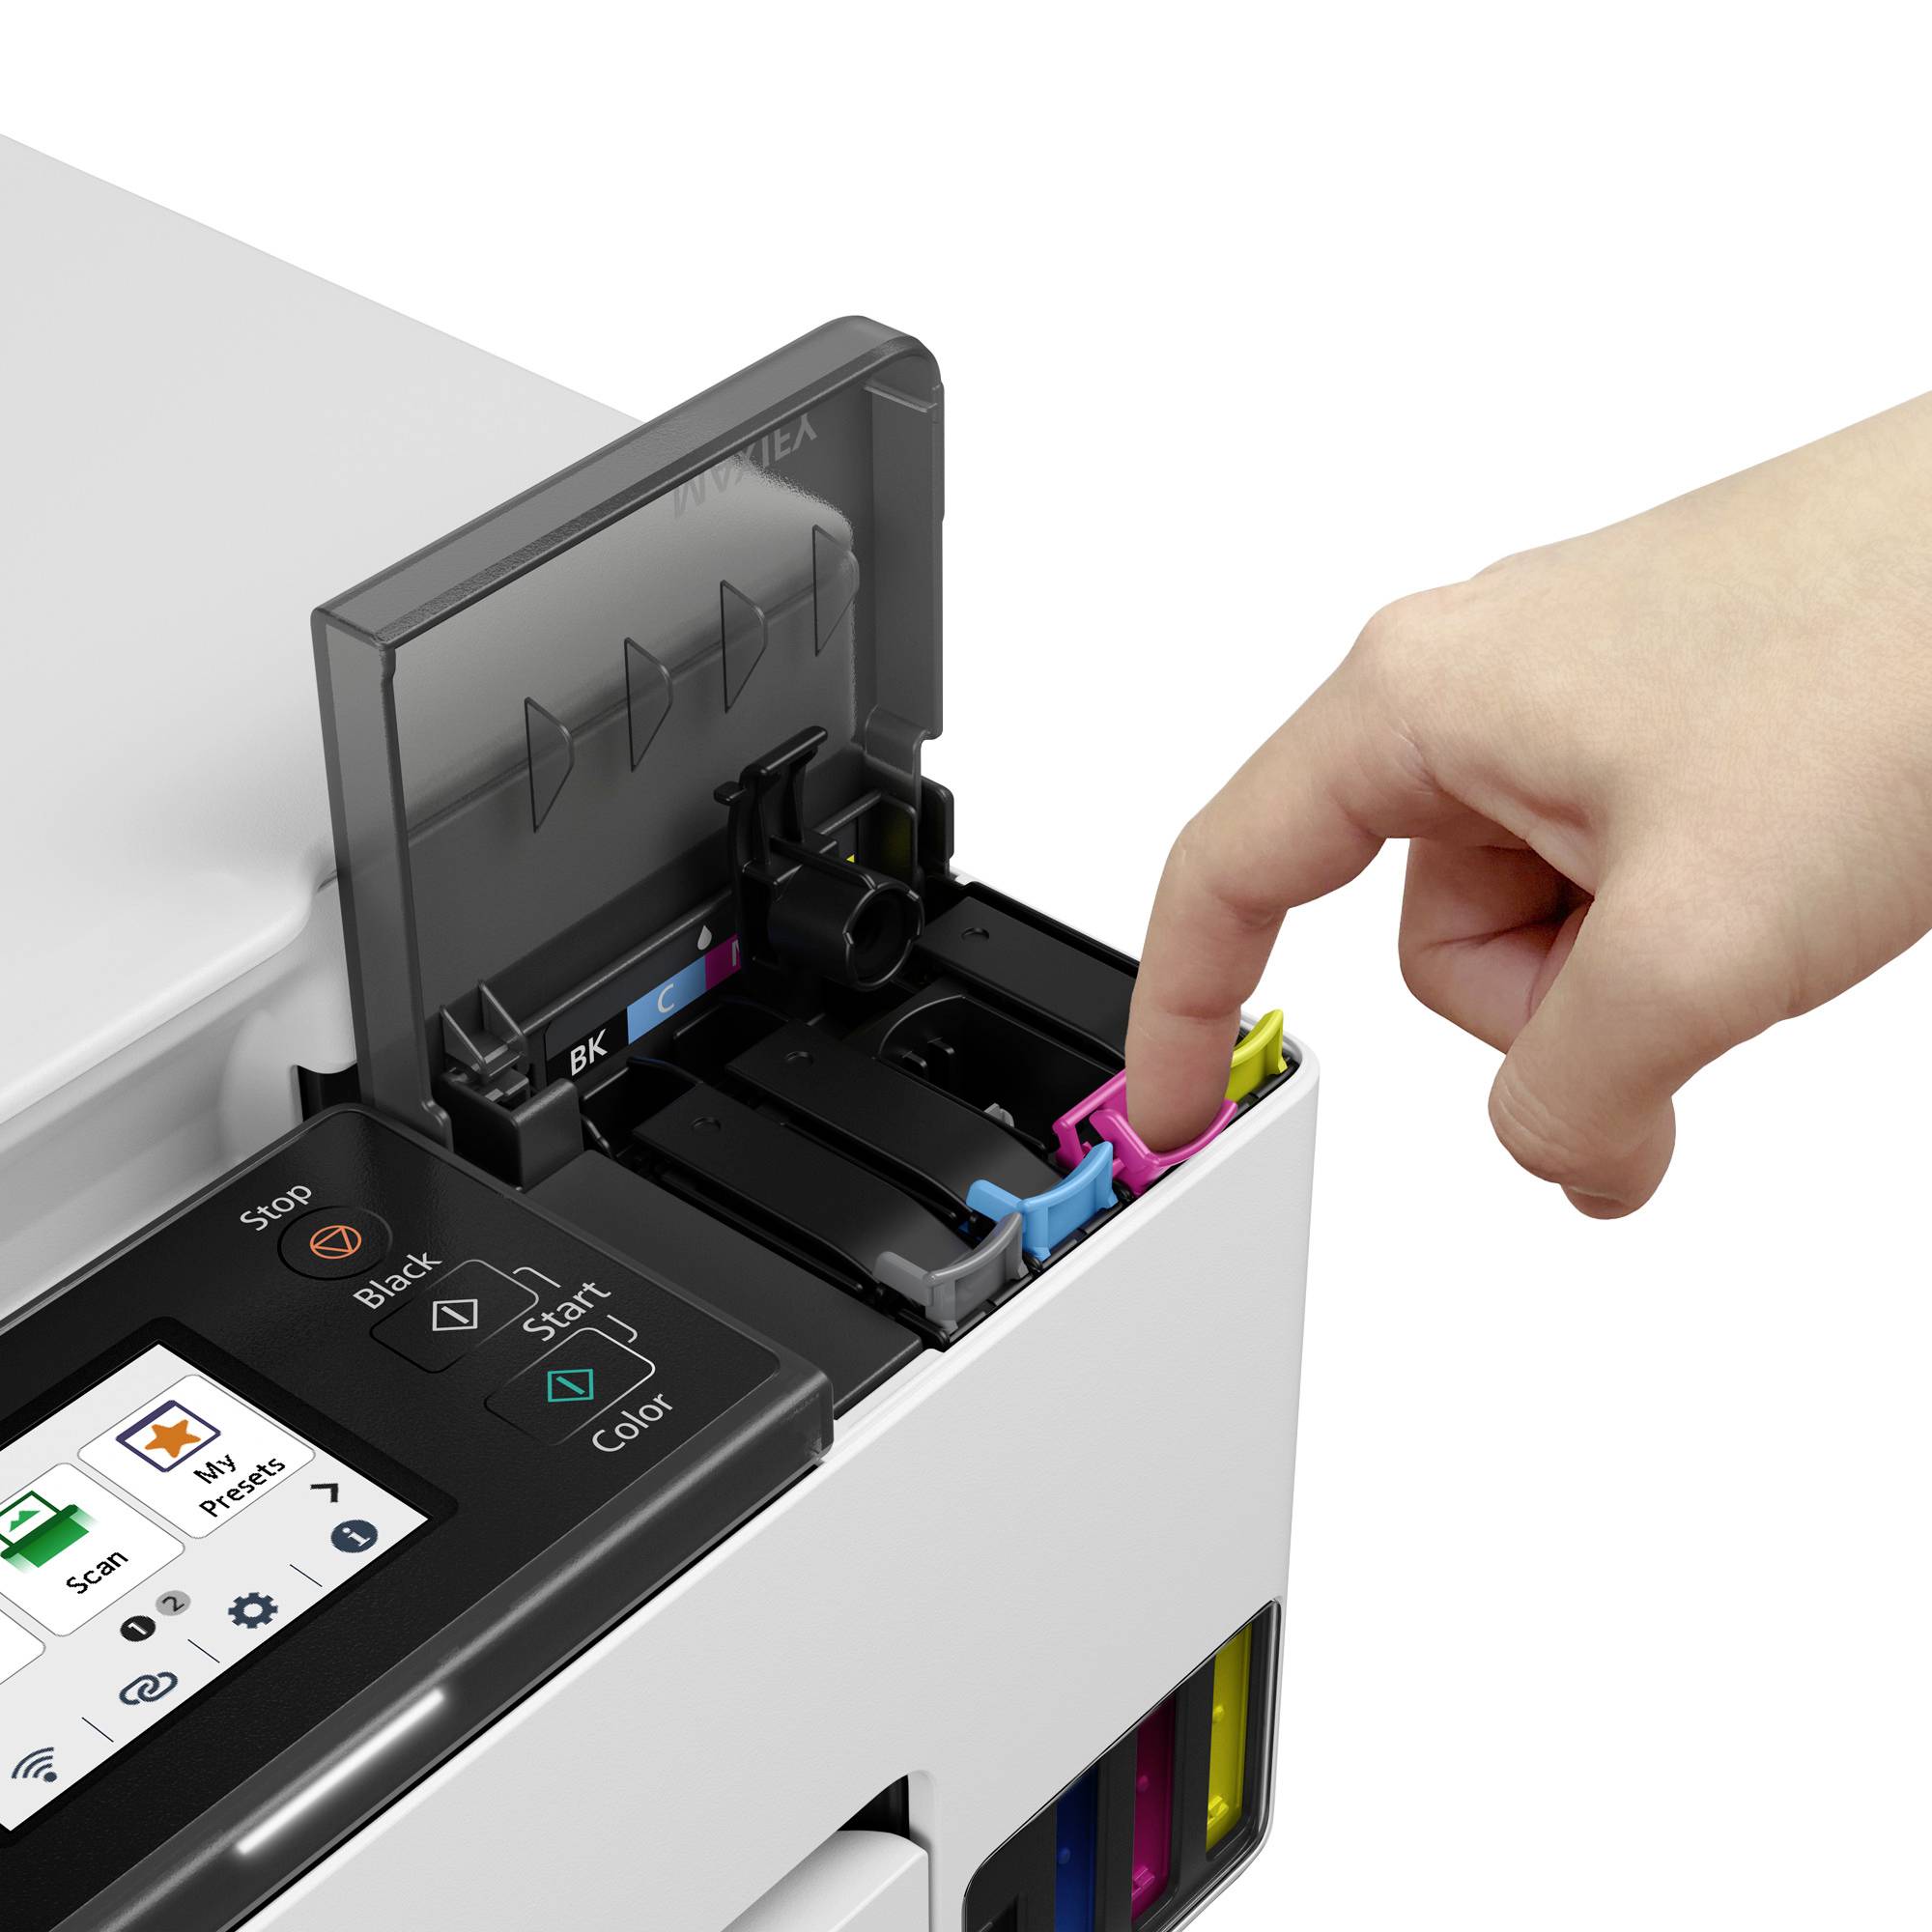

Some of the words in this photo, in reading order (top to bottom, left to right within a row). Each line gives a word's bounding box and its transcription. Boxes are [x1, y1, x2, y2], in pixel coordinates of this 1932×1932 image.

[571, 1029, 608, 1076] BK
[657, 983, 675, 1013] C
[240, 1183, 312, 1232] Stop
[353, 1251, 441, 1310] Black
[523, 1280, 611, 1342] Start
[591, 1393, 673, 1453] Color
[193, 1453, 236, 1485] My
[199, 1456, 286, 1518] Presets
[67, 1550, 129, 1595] Scan
[161, 1596, 185, 1612] 2
